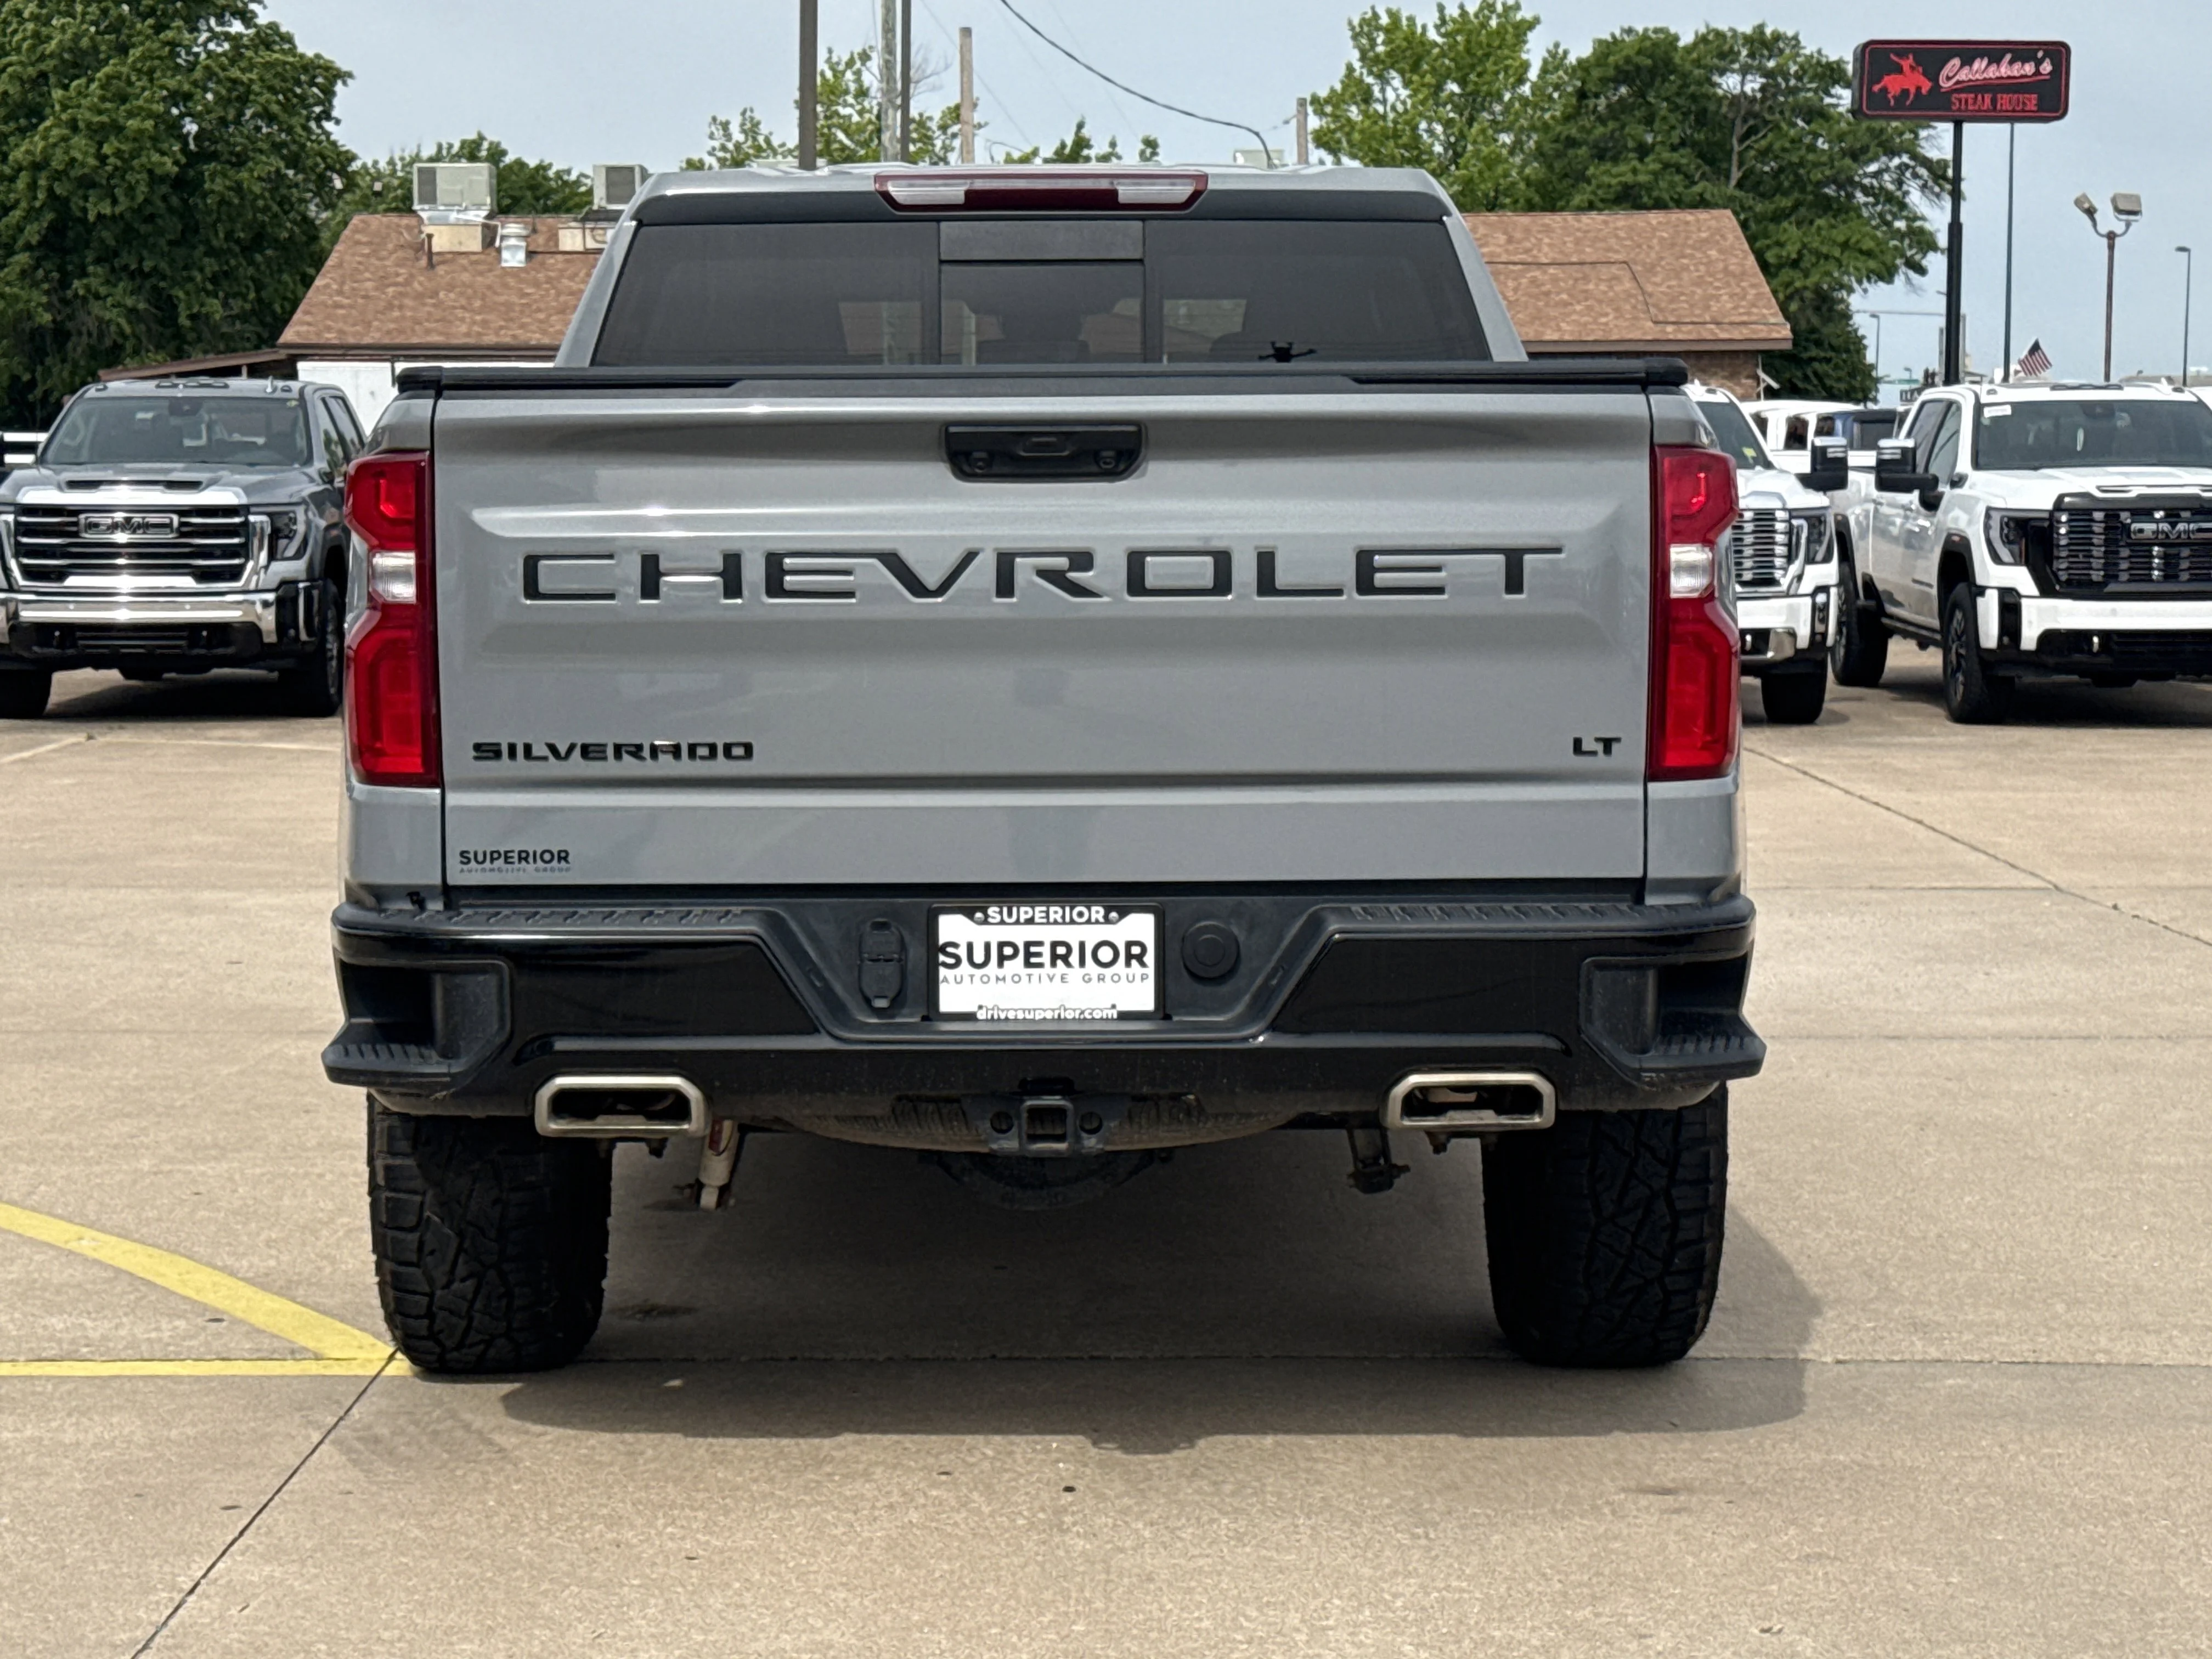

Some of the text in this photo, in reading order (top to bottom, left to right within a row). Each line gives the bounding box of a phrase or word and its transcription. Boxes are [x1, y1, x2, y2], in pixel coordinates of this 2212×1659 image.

[1939, 50, 2053, 88] Callahan's
[1951, 93, 2039, 111] STEAK HOUSE
[87, 517, 171, 534] GMC
[523, 548, 1564, 602] CHEVROLET
[472, 741, 754, 761] SILVERADO
[1573, 737, 1622, 757] LT
[459, 849, 571, 865] SUPERIOR
[987, 906, 1105, 923] SUPERIOR
[939, 940, 1150, 970] SUPERIOR
[939, 973, 1150, 985] AUTOMOTIVE GROUP
[976, 1006, 1118, 1021] drivesuperior.com
